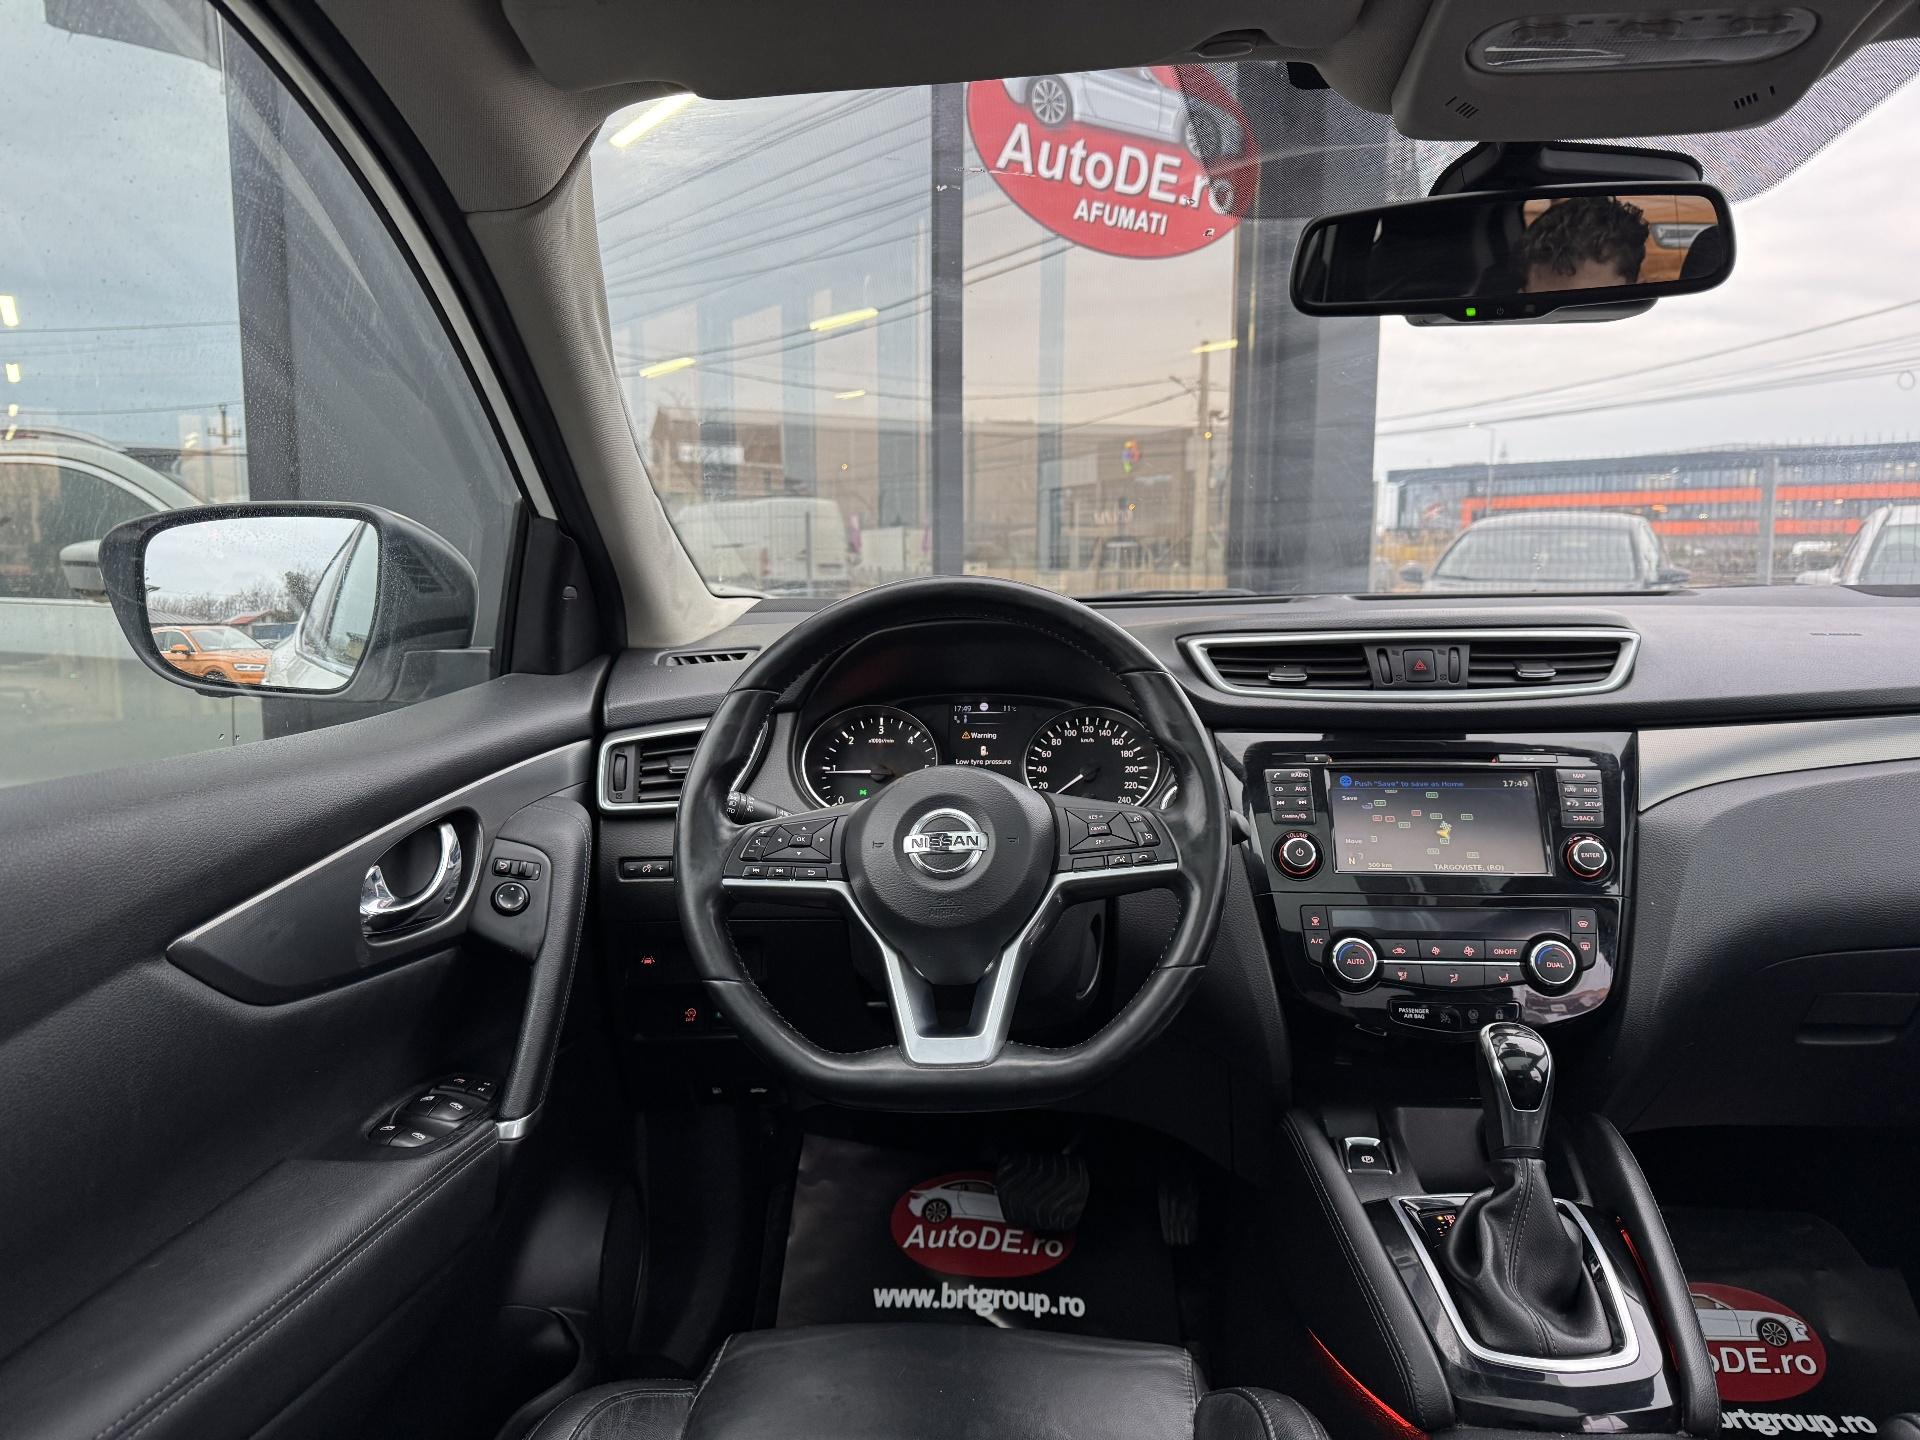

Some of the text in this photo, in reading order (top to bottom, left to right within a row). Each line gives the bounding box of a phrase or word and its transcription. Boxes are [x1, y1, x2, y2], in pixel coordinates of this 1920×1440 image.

[996, 122, 1236, 216] AutoDE.ro
[1073, 198, 1168, 236] AFUMATI
[878, 726, 885, 735] 3
[1064, 729, 1077, 737] 100
[1081, 725, 1095, 733] 120
[1098, 729, 1112, 737] 140
[970, 732, 997, 740] Warning
[848, 736, 855, 745] 2
[907, 736, 914, 745] 4
[1051, 738, 1062, 746] 80
[1111, 738, 1125, 746] 160
[1041, 750, 1052, 758] 60
[1120, 750, 1134, 758] 180
[1354, 780, 1373, 788] Push
[1502, 780, 1529, 788] 17:49
[837, 795, 845, 804] 0
[1117, 796, 1131, 804] 240
[911, 835, 979, 849] NISSAN
[1348, 857, 1356, 865] N
[1486, 864, 1504, 872] (RO)
[902, 1223, 1064, 1258] AutoDE.ro
[872, 1281, 1086, 1318] www.brtgroup.ro
